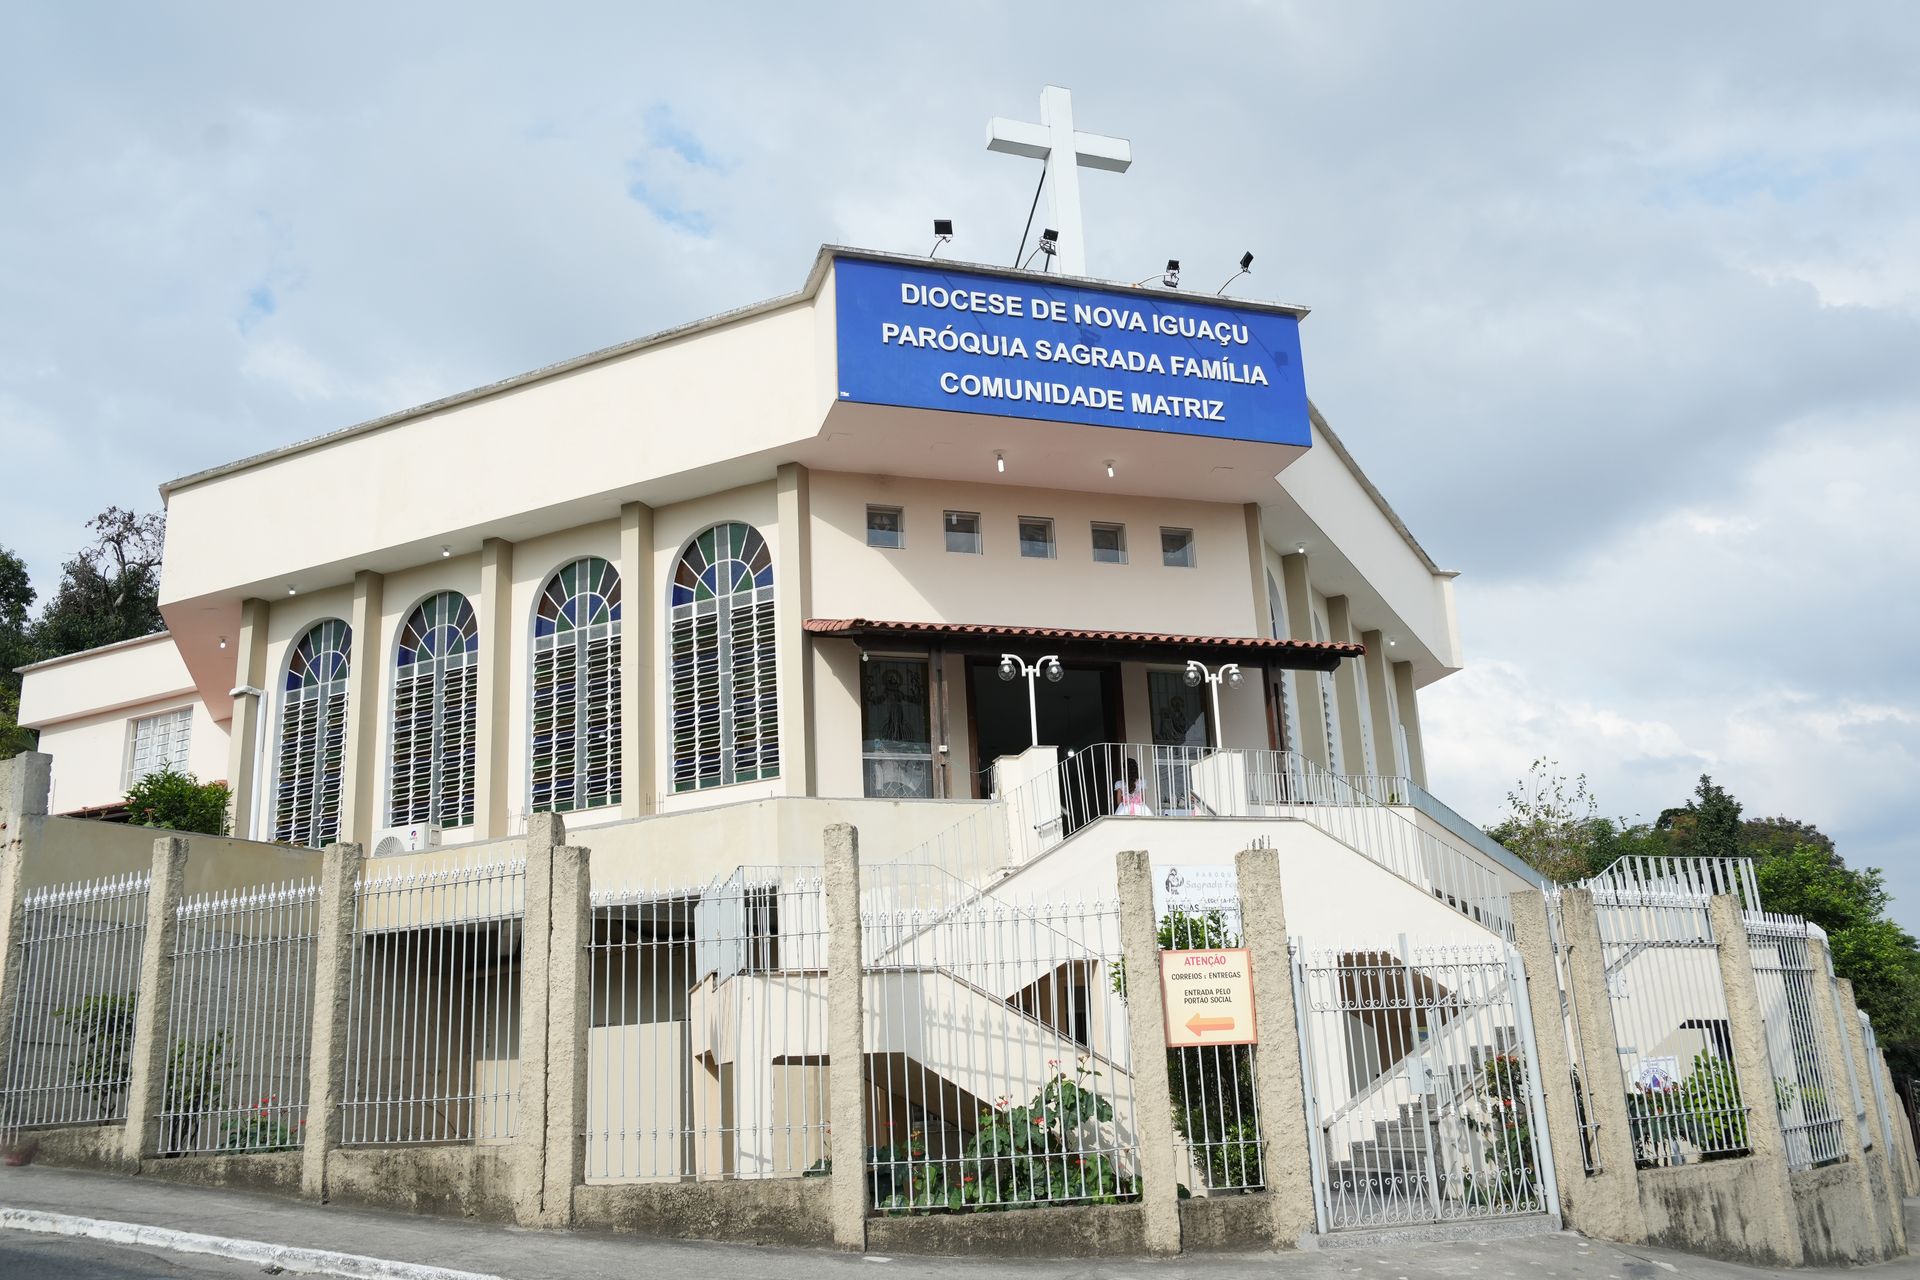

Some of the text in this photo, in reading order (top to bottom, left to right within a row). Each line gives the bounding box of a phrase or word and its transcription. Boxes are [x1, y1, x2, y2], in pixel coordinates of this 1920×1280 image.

[901, 283, 1249, 345] DIOCESE DE NOVA IGUAÇU
[882, 323, 1269, 385] PARÓQUIA SAGRADA FAMÍLIA
[940, 372, 1226, 421] COMUNIDADE MATRIZ
[1184, 954, 1226, 967] ATENÇÃO
[1208, 971, 1241, 979] ENTREGAS
[1184, 995, 1209, 1004] PORTÃO
